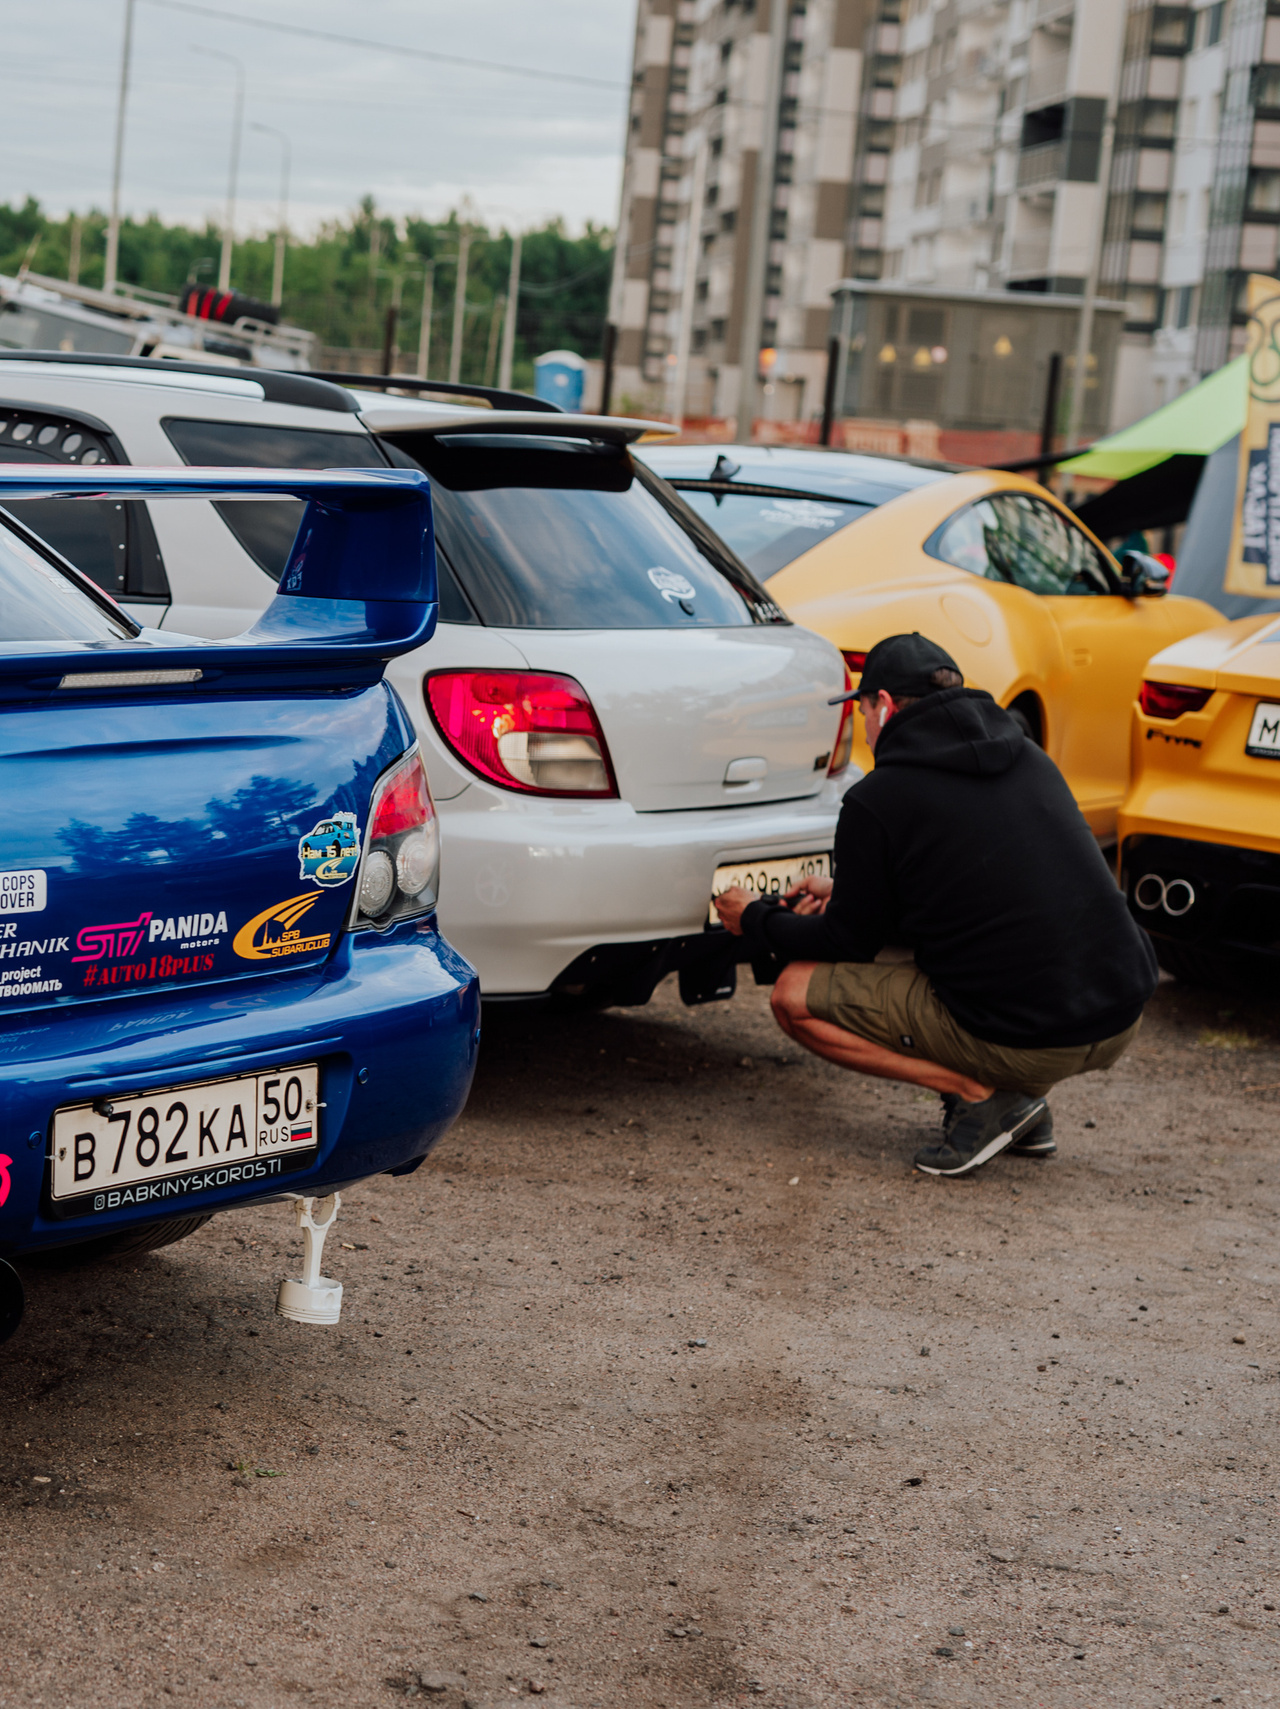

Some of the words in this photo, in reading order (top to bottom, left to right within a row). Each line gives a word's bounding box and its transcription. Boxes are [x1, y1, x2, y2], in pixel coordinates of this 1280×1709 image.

[302, 847, 322, 859] Нам
[326, 845, 337, 858] 15
[2, 874, 35, 891] COPS
[0, 891, 35, 909] OVER
[148, 911, 228, 942] PANIDA
[281, 929, 301, 942] SPB
[180, 938, 220, 950] motors
[271, 937, 331, 959] SUBARUCLUB
[83, 953, 215, 987] #AUTO18PLUS
[262, 1075, 303, 1126] 50
[259, 1126, 290, 1147] RUS
